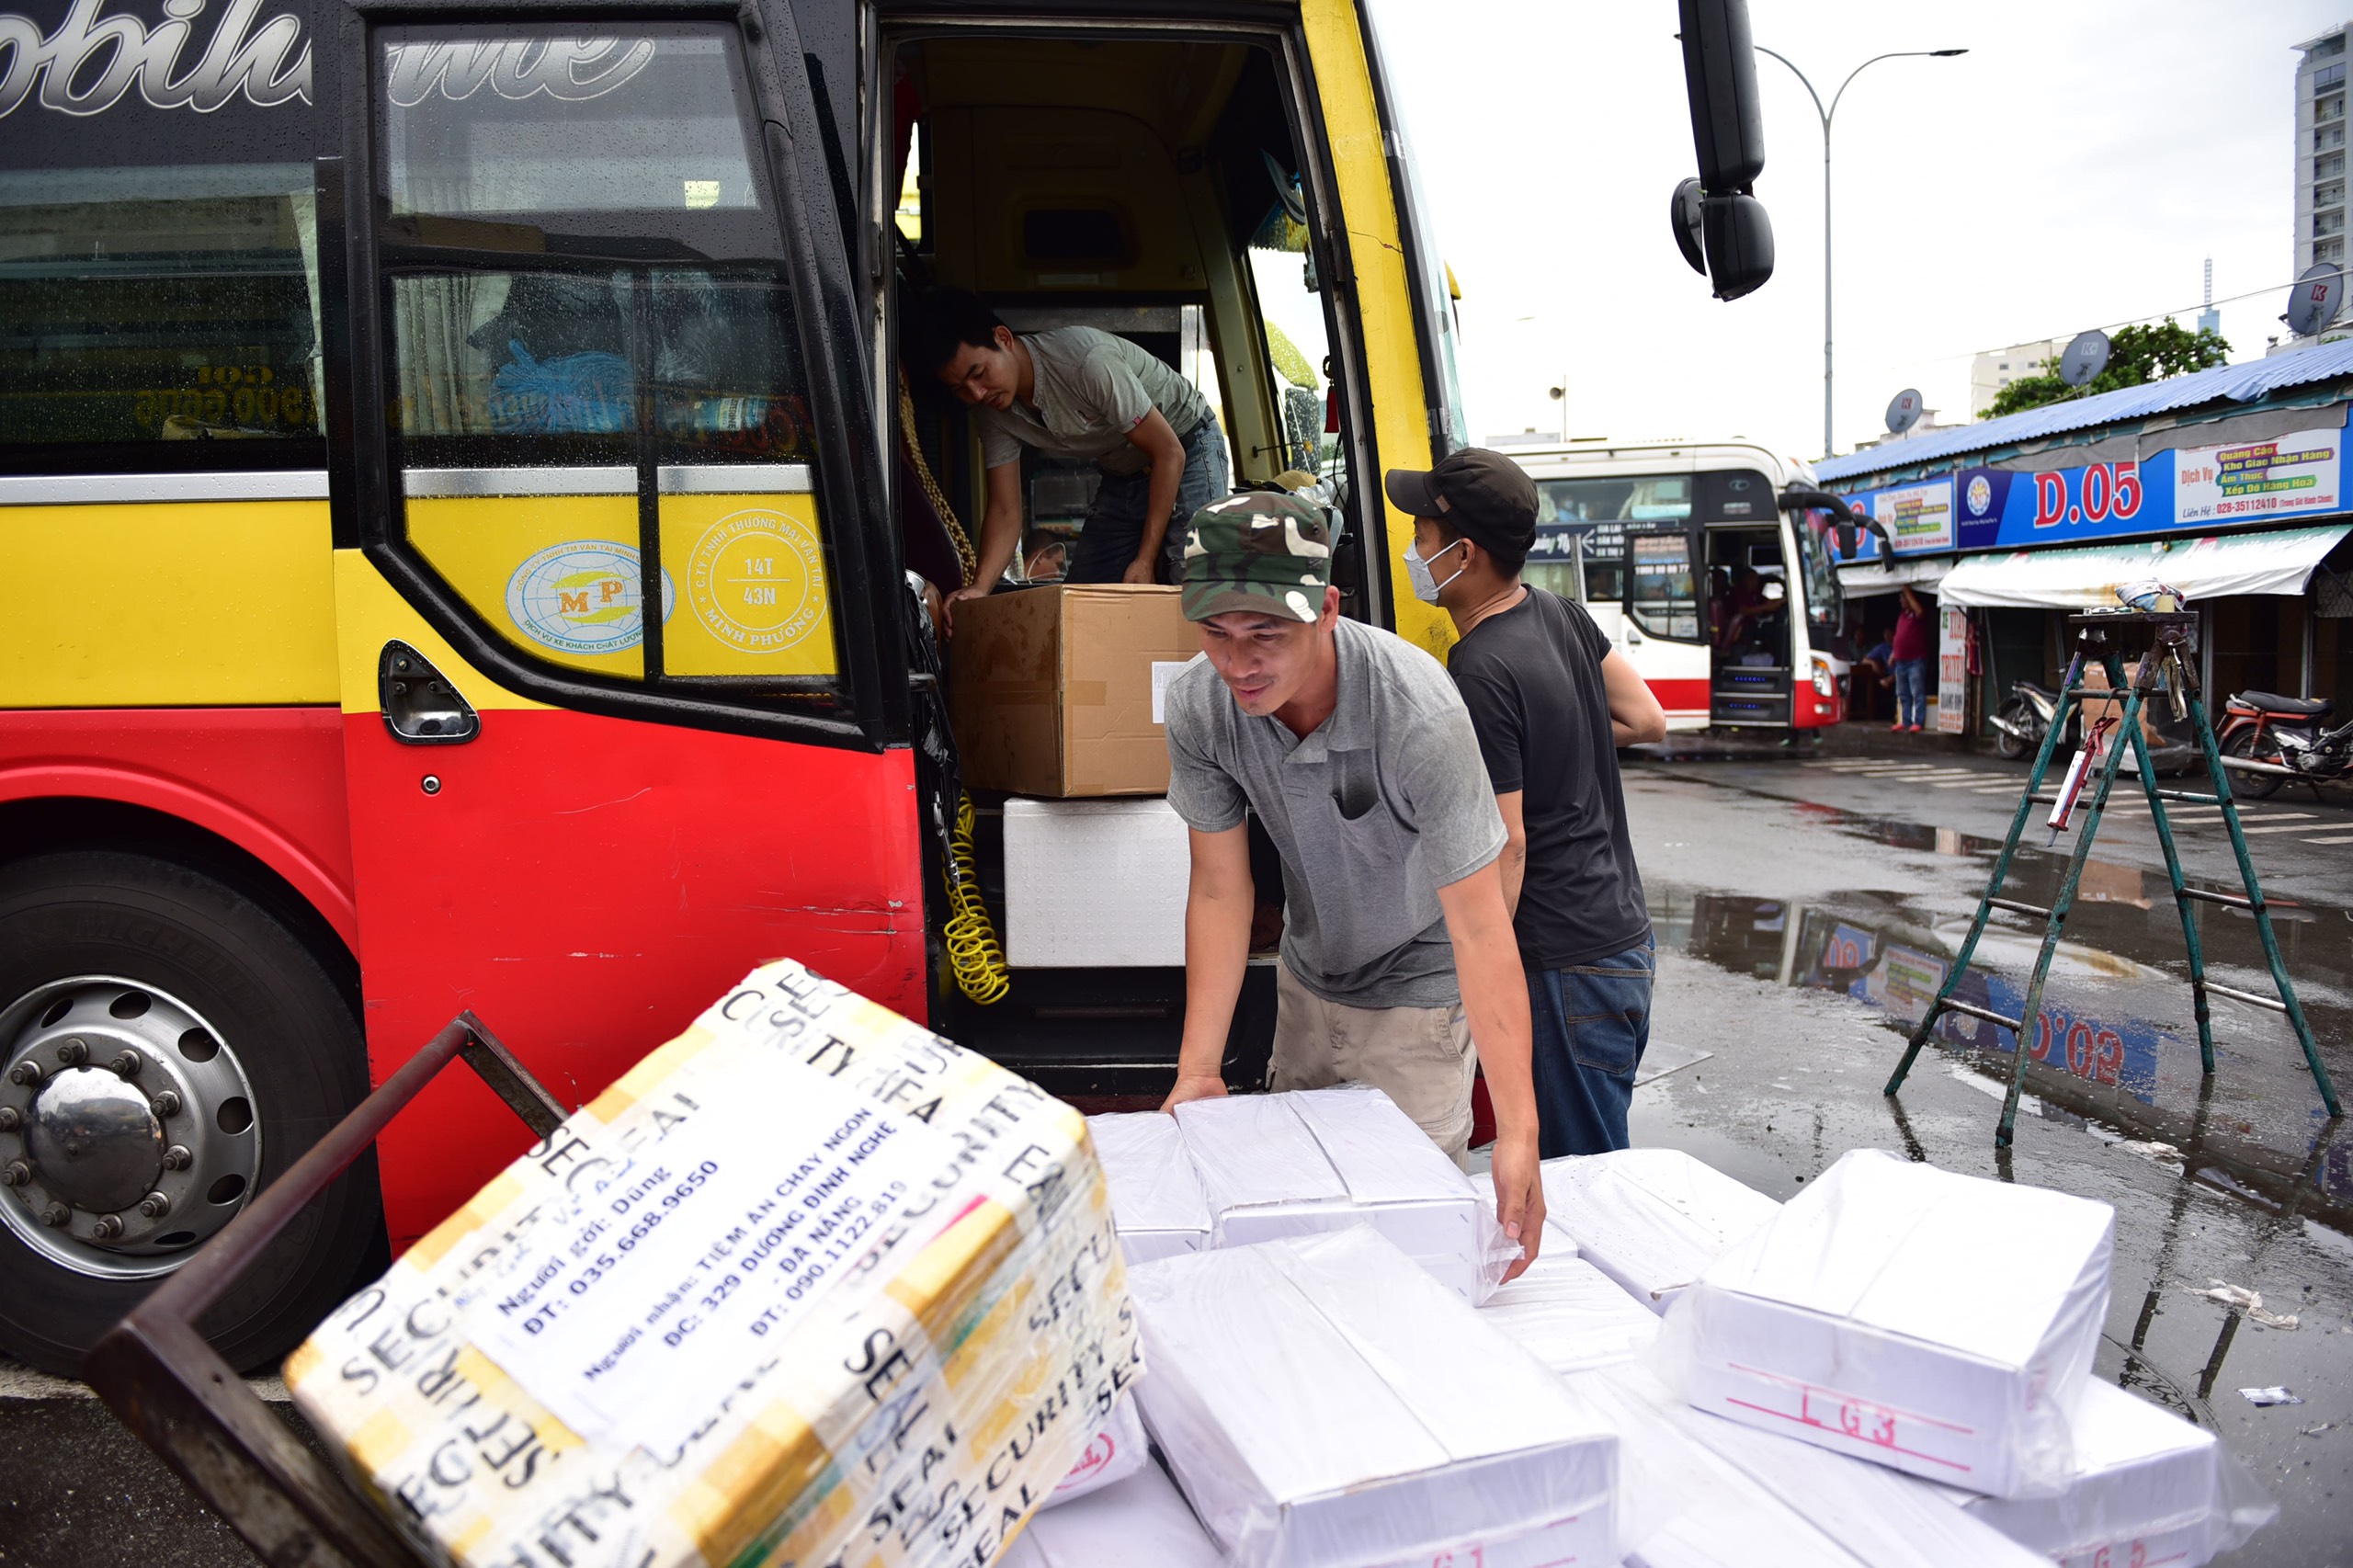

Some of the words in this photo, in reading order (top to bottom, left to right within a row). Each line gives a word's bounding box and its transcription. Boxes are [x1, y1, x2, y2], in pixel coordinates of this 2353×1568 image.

[2223, 462, 2243, 472] Kho
[2245, 459, 2268, 469] Giao
[2034, 463, 2142, 528] D.05
[2216, 497, 2278, 515] 028-35112410
[702, 528, 729, 558] TNHH
[745, 557, 774, 576] 14T
[743, 586, 777, 606] 43N
[524, 619, 541, 636] DỊCH
[553, 637, 564, 647] XE
[565, 639, 596, 651] KHÁCH
[705, 607, 746, 643] MINH
[775, 1152, 824, 1198] CHAY
[823, 1106, 873, 1153] NGON
[610, 1165, 672, 1215] Dũng
[523, 1298, 569, 1335] ĐT:
[568, 1160, 719, 1296] 035.668.9650
[663, 1313, 704, 1348] ĐC:
[699, 1272, 742, 1314] 329
[740, 1209, 805, 1273] DƯƠNG
[802, 1165, 851, 1210] ĐÌNH
[749, 1302, 789, 1336] ĐT:
[786, 1179, 908, 1301] 090.1122.819
